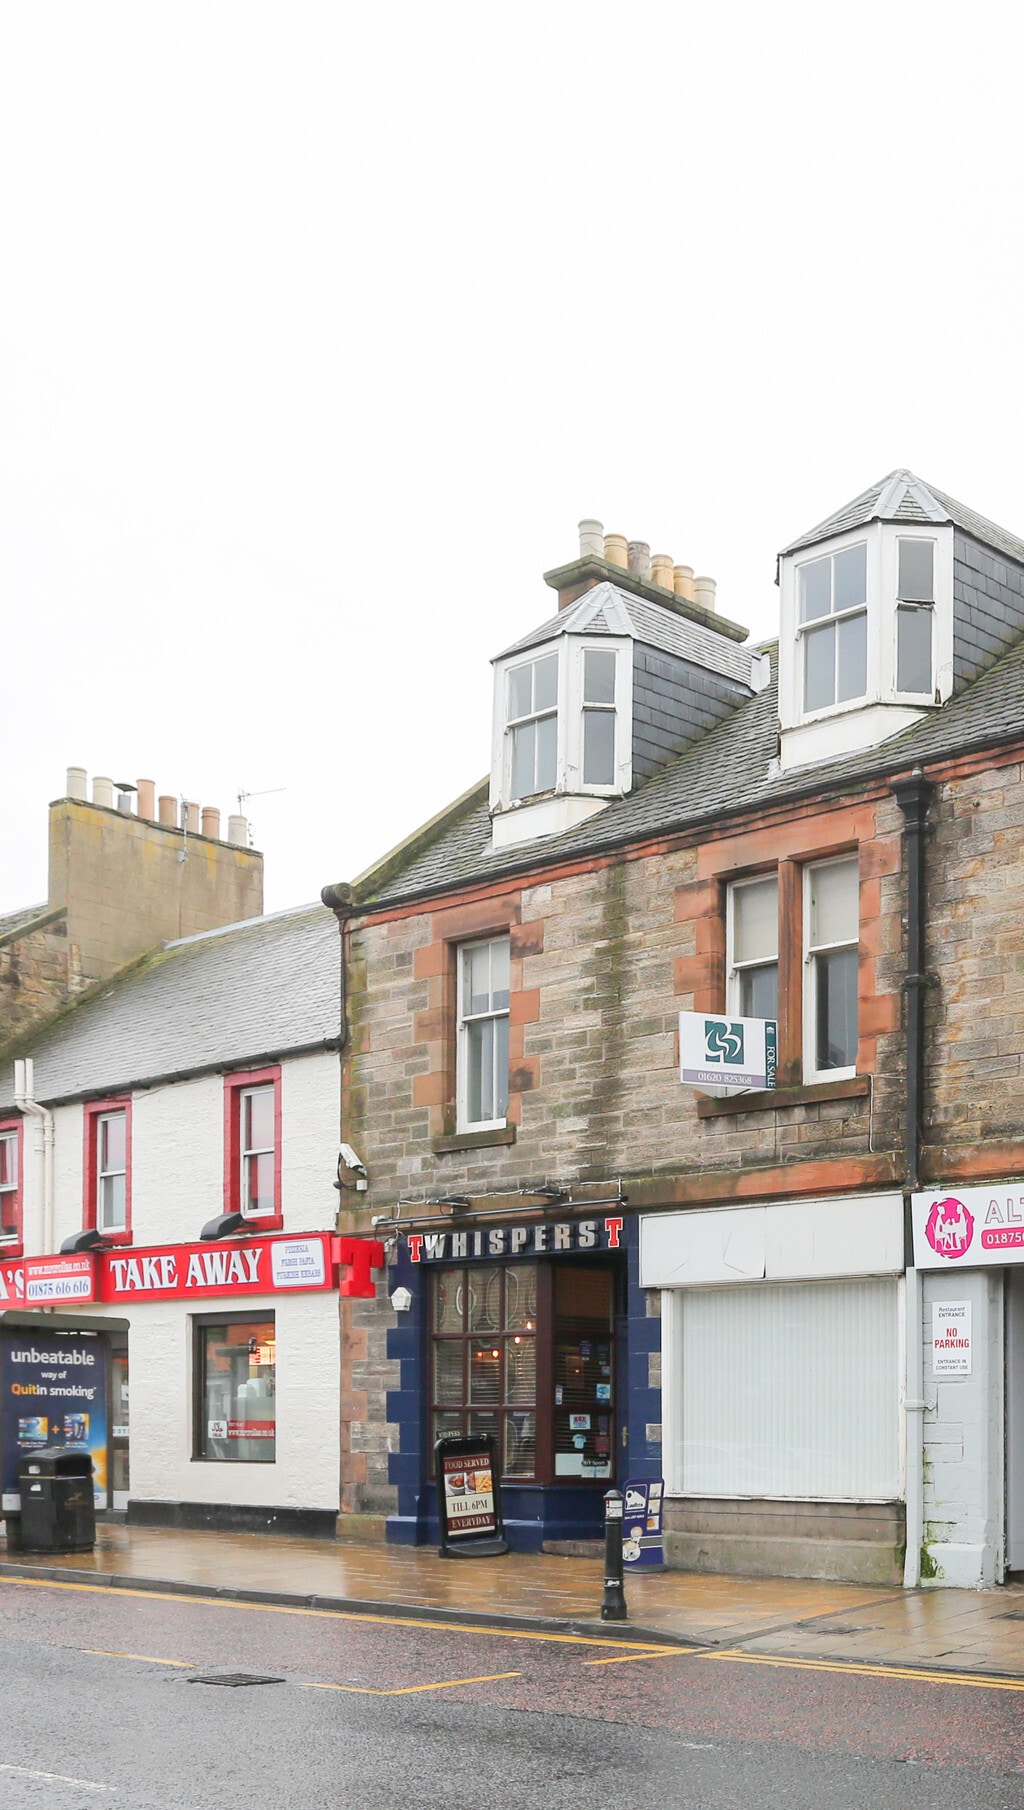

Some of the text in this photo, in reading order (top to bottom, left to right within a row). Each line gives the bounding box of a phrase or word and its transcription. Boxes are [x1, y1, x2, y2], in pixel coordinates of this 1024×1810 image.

[767, 1046, 776, 1087] FOR SALE
[698, 1072, 752, 1085] 01620 825368
[424, 1220, 598, 1260] WHISPERS
[109, 1248, 263, 1292] TAKE AWAY
[28, 1280, 89, 1297] 01875 616 616
[946, 1328, 958, 1337] NO
[934, 1338, 970, 1349] PARKING
[11, 1347, 95, 1366] unbeatable
[41, 1370, 67, 1381] way of
[11, 1383, 48, 1396] Quitin
[444, 1458, 490, 1470] FOOD SERVED
[451, 1499, 488, 1512] TILL 6PM
[451, 1515, 491, 1528] EVERYDAY
